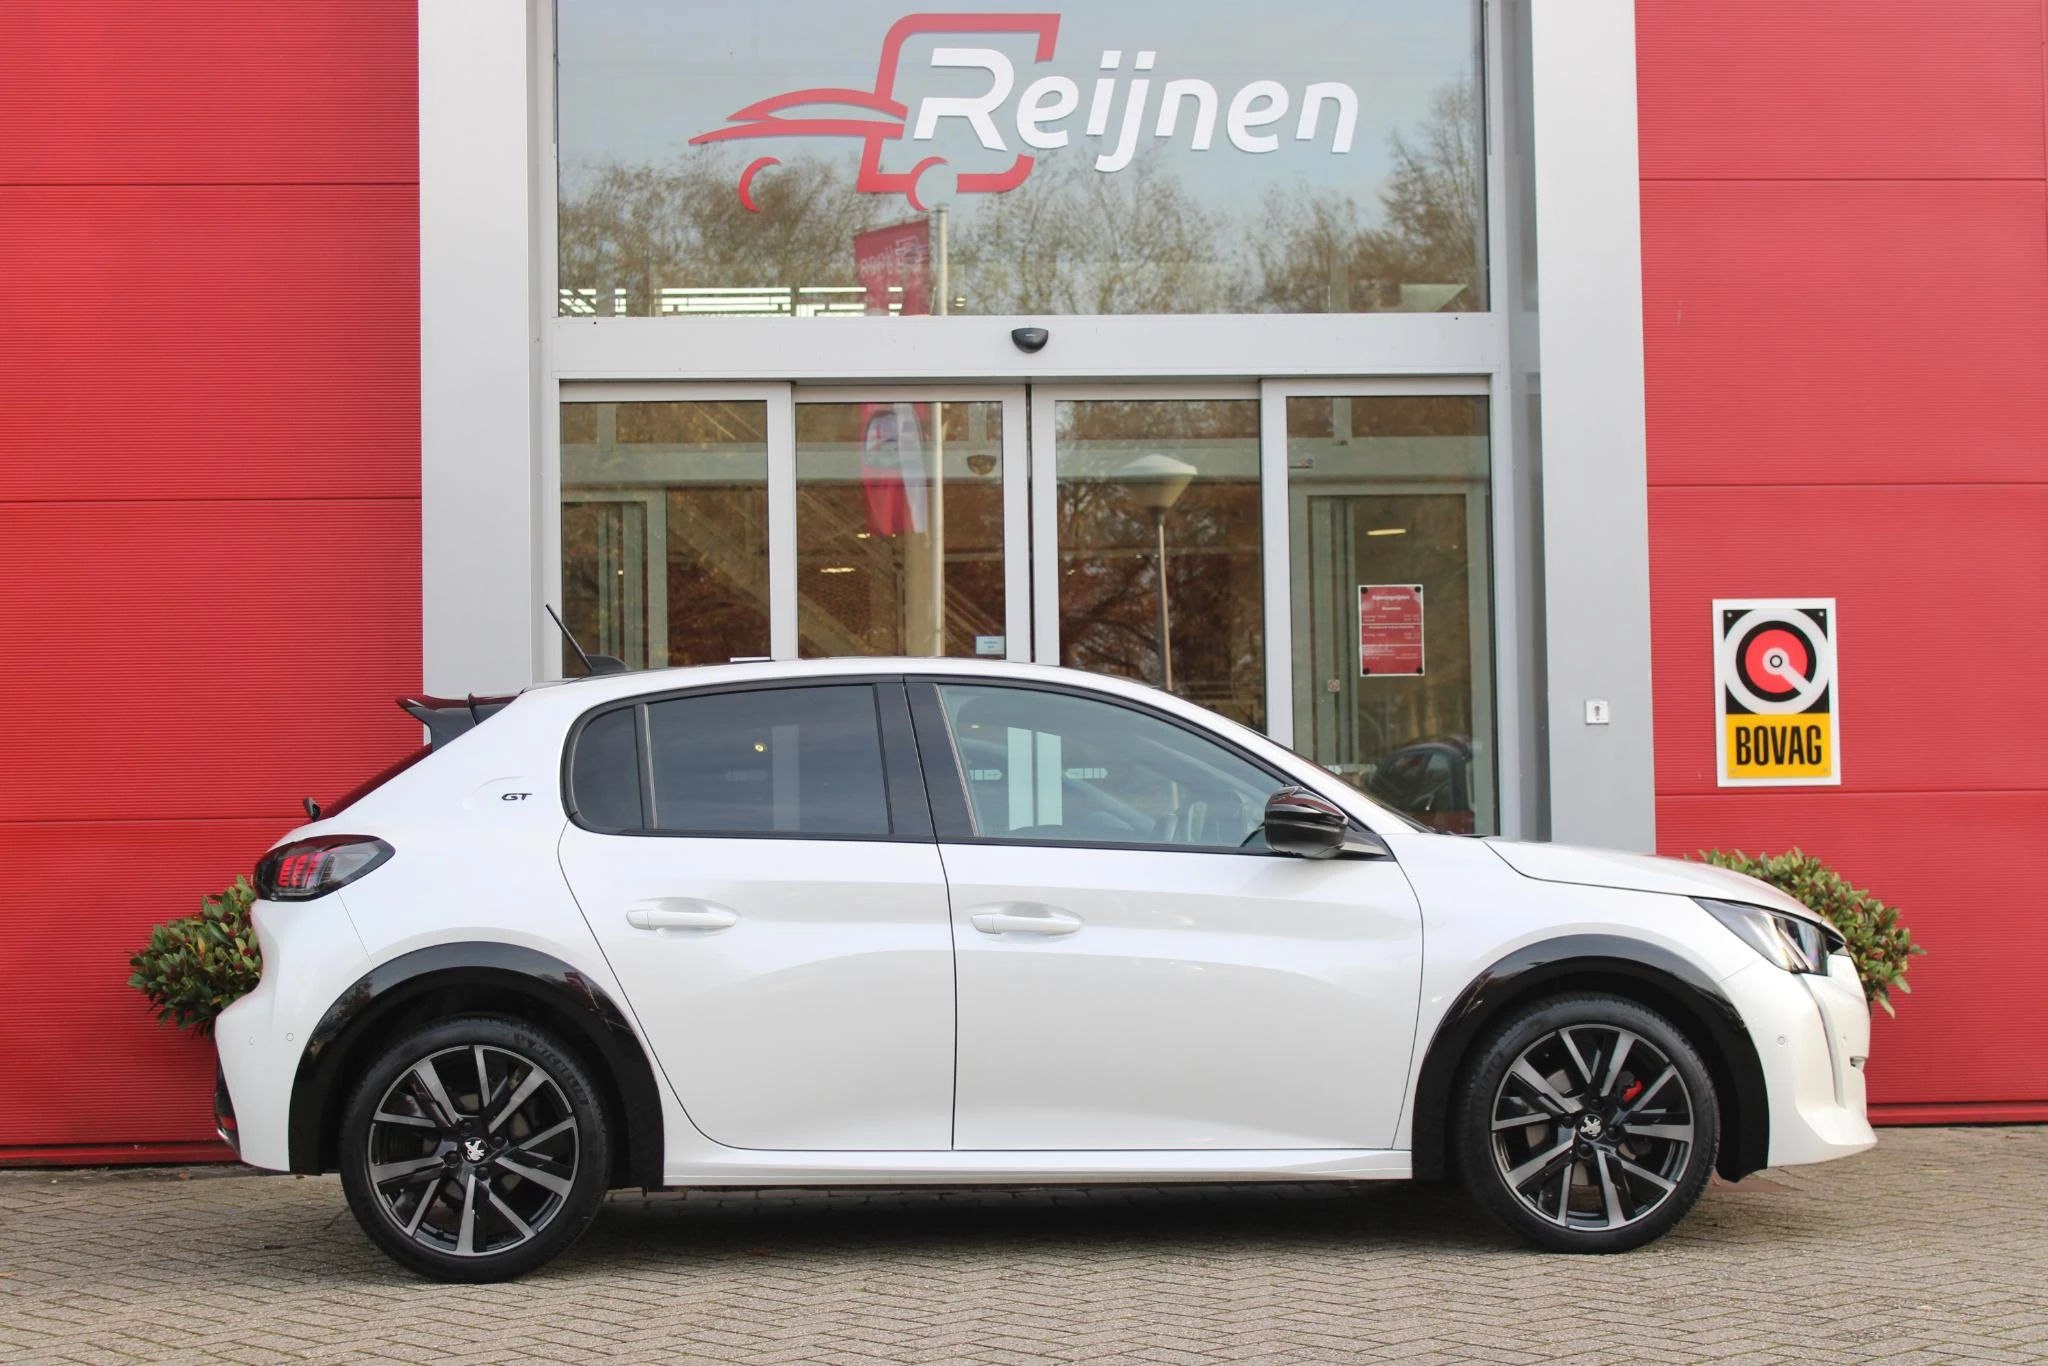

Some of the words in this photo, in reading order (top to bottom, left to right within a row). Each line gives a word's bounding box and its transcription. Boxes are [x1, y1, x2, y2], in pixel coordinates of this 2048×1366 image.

[913, 47, 1359, 173] Reijnen
[1735, 725, 1822, 766] BOVAG
[501, 792, 533, 801] GT
